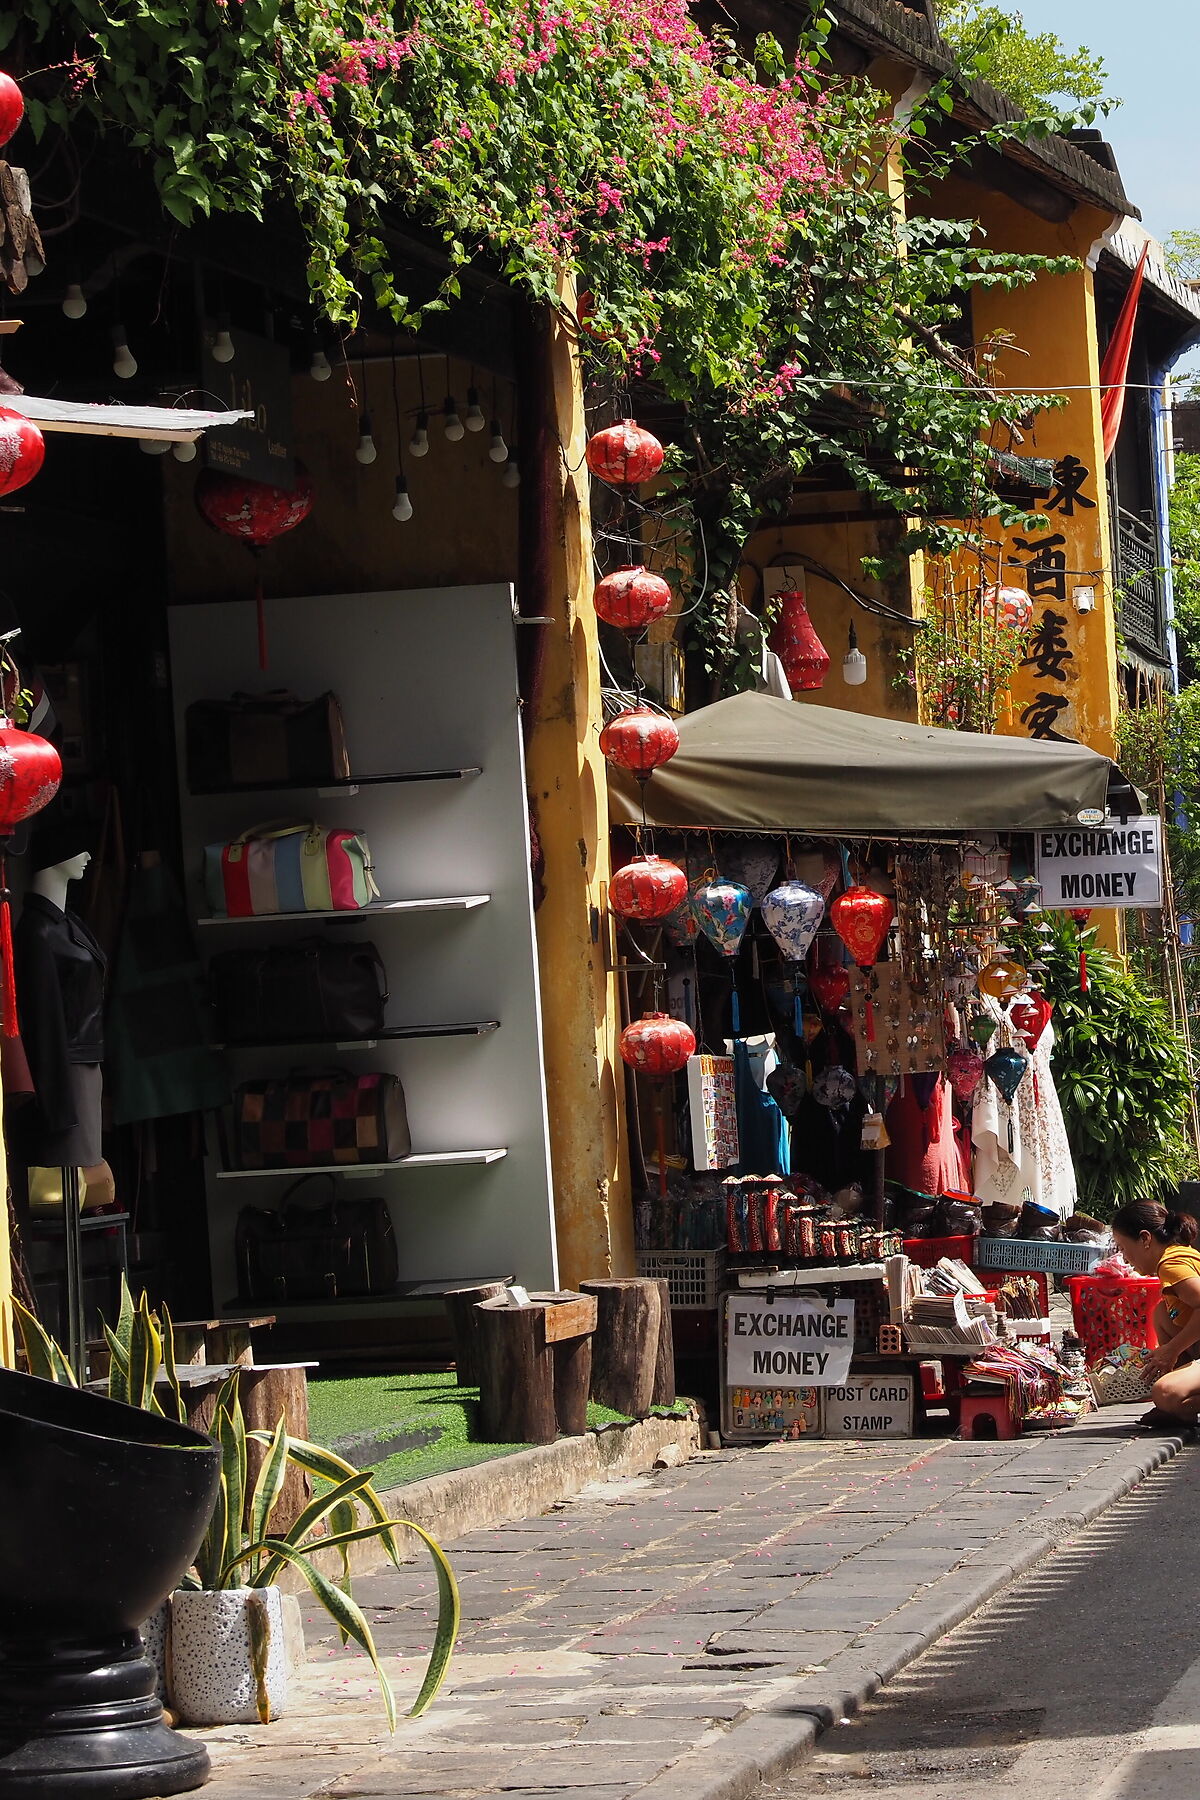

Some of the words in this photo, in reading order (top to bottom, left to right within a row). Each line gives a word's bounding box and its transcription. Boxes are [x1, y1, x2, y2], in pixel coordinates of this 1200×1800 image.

[1041, 830, 1155, 858] EXCHANGE
[1060, 872, 1137, 899] MONEY
[734, 1312, 849, 1339] EXCHANGE
[753, 1350, 830, 1376] MONEY
[827, 1387, 865, 1402] POST
[869, 1387, 909, 1402] CARD
[843, 1416, 893, 1431] STAMP
